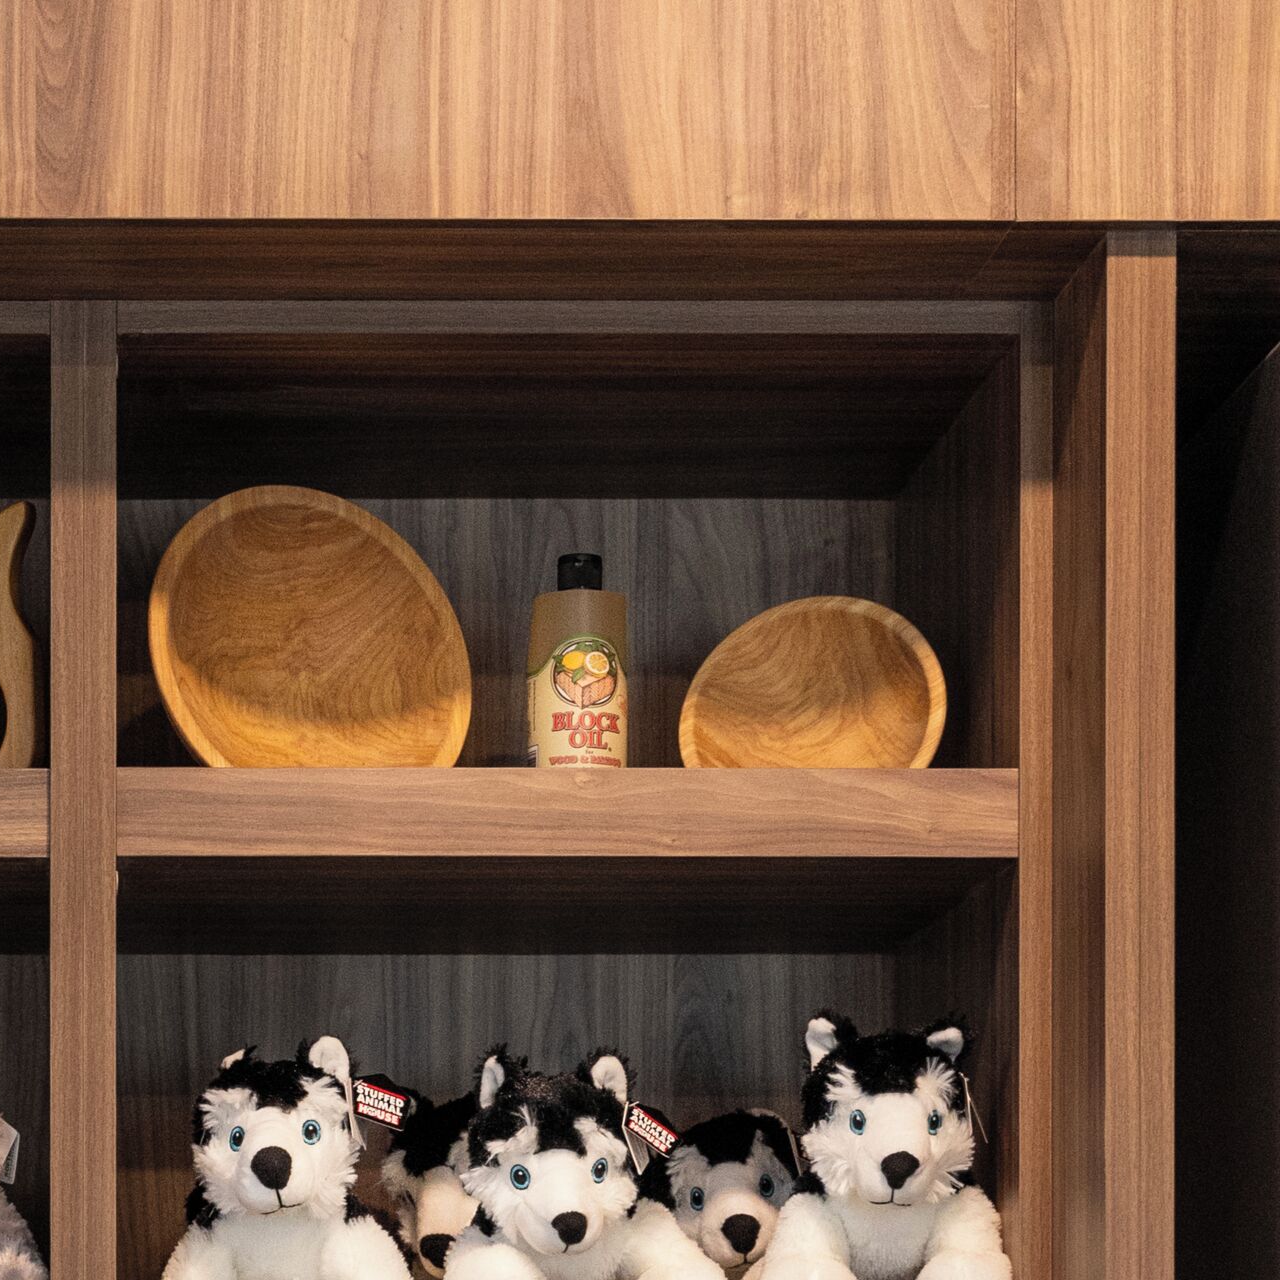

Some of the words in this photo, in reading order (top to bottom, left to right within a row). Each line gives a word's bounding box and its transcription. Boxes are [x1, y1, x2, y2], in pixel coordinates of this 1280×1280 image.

[551, 710, 620, 734] BLOCK
[568, 729, 609, 750] OIL
[356, 1084, 405, 1108] STUFFED
[356, 1093, 403, 1117] ANIMAL
[357, 1103, 399, 1126] HOUSE
[631, 1108, 676, 1143] STUFFED
[629, 1115, 672, 1149] ANIMAL
